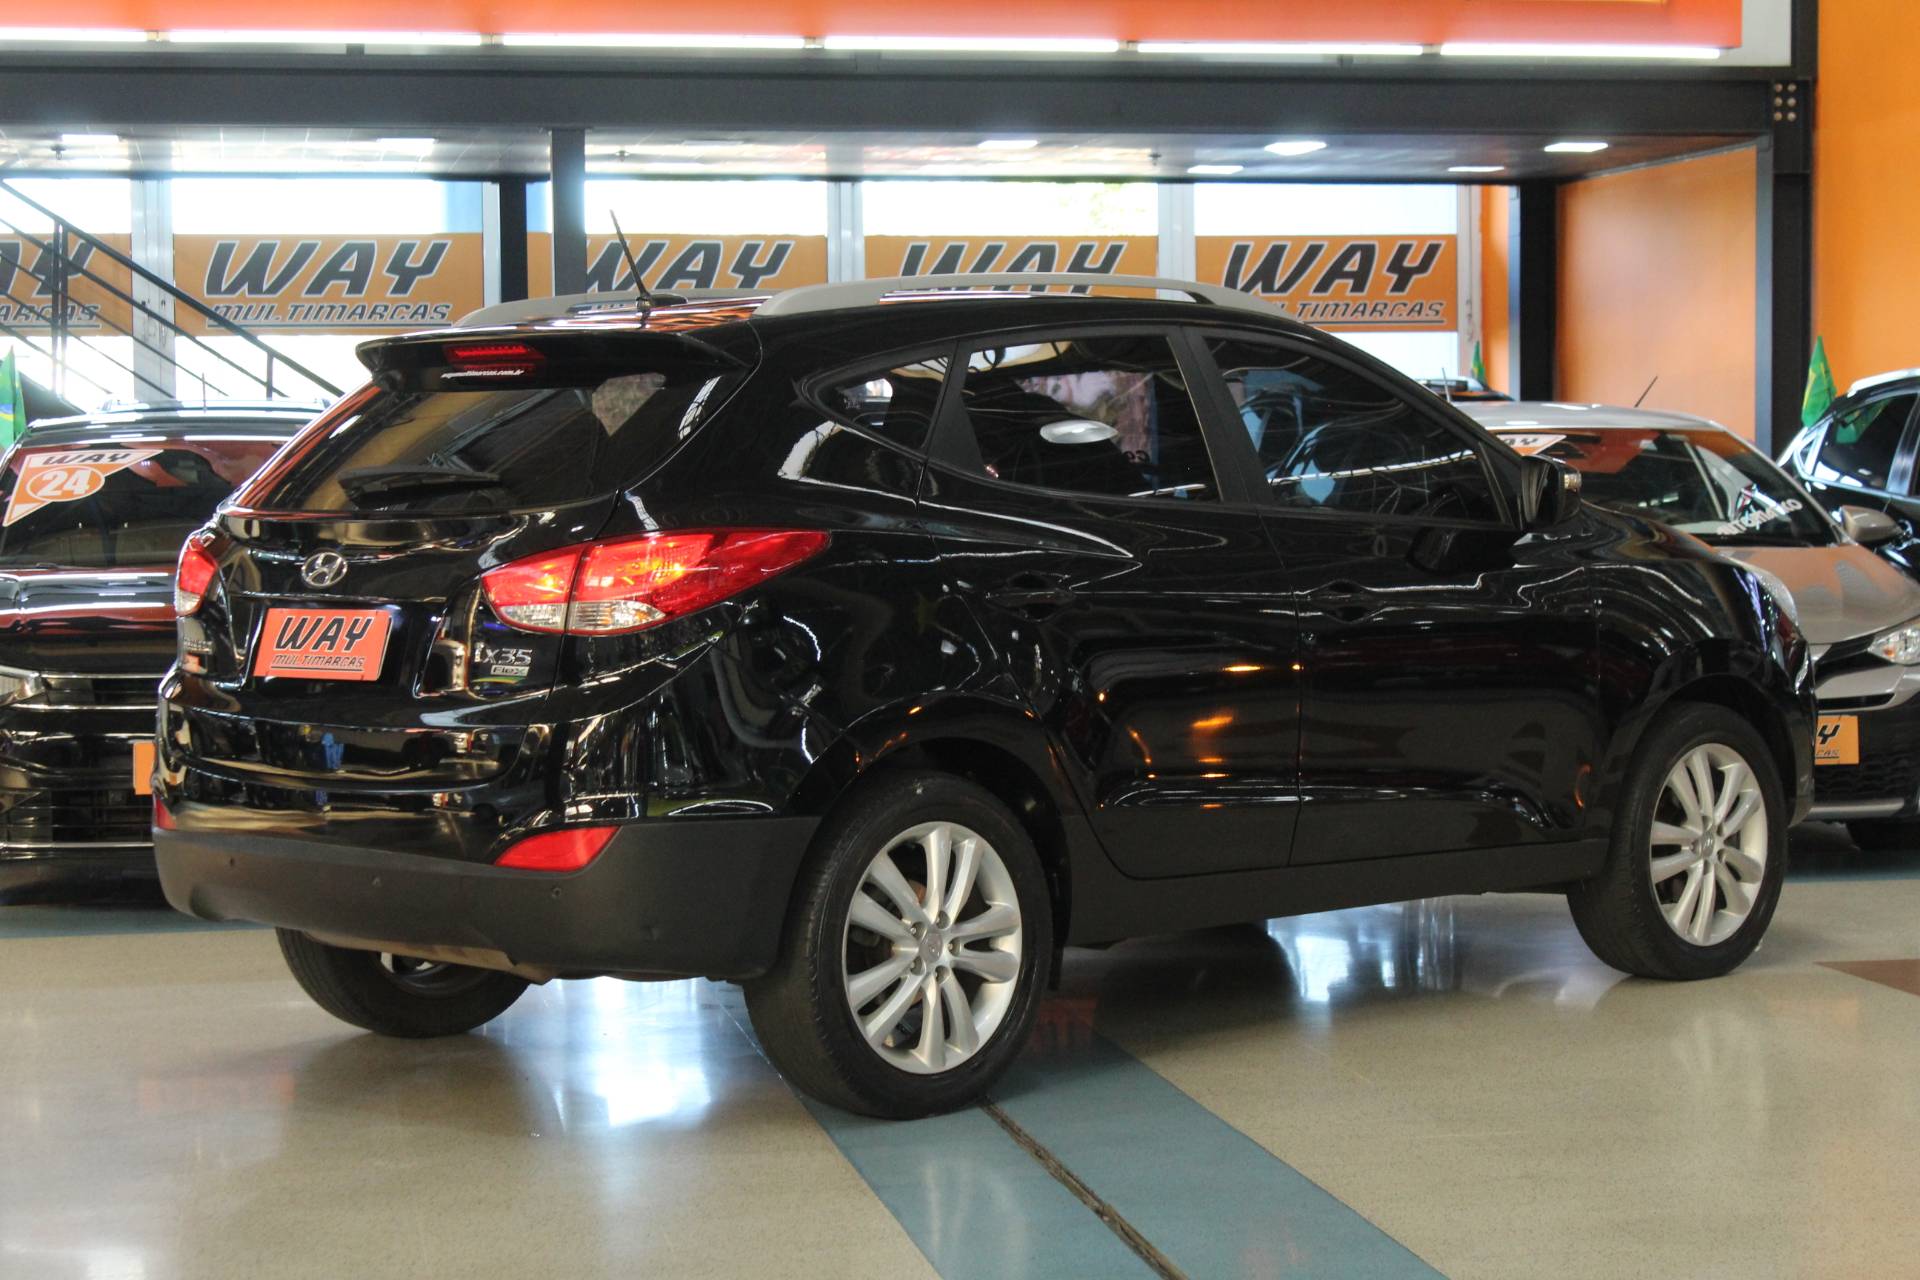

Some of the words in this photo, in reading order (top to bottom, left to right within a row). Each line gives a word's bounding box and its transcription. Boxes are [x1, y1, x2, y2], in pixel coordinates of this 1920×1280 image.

[204, 239, 452, 298] WAY
[1222, 240, 1446, 297] WAY
[208, 303, 453, 321] MULTIMARCAS
[1280, 301, 1446, 318] TIMARCAS
[42, 453, 131, 465] WAY
[35, 469, 92, 497] 24
[273, 615, 375, 653] WAY
[272, 653, 365, 669] MULTIMARCAS
